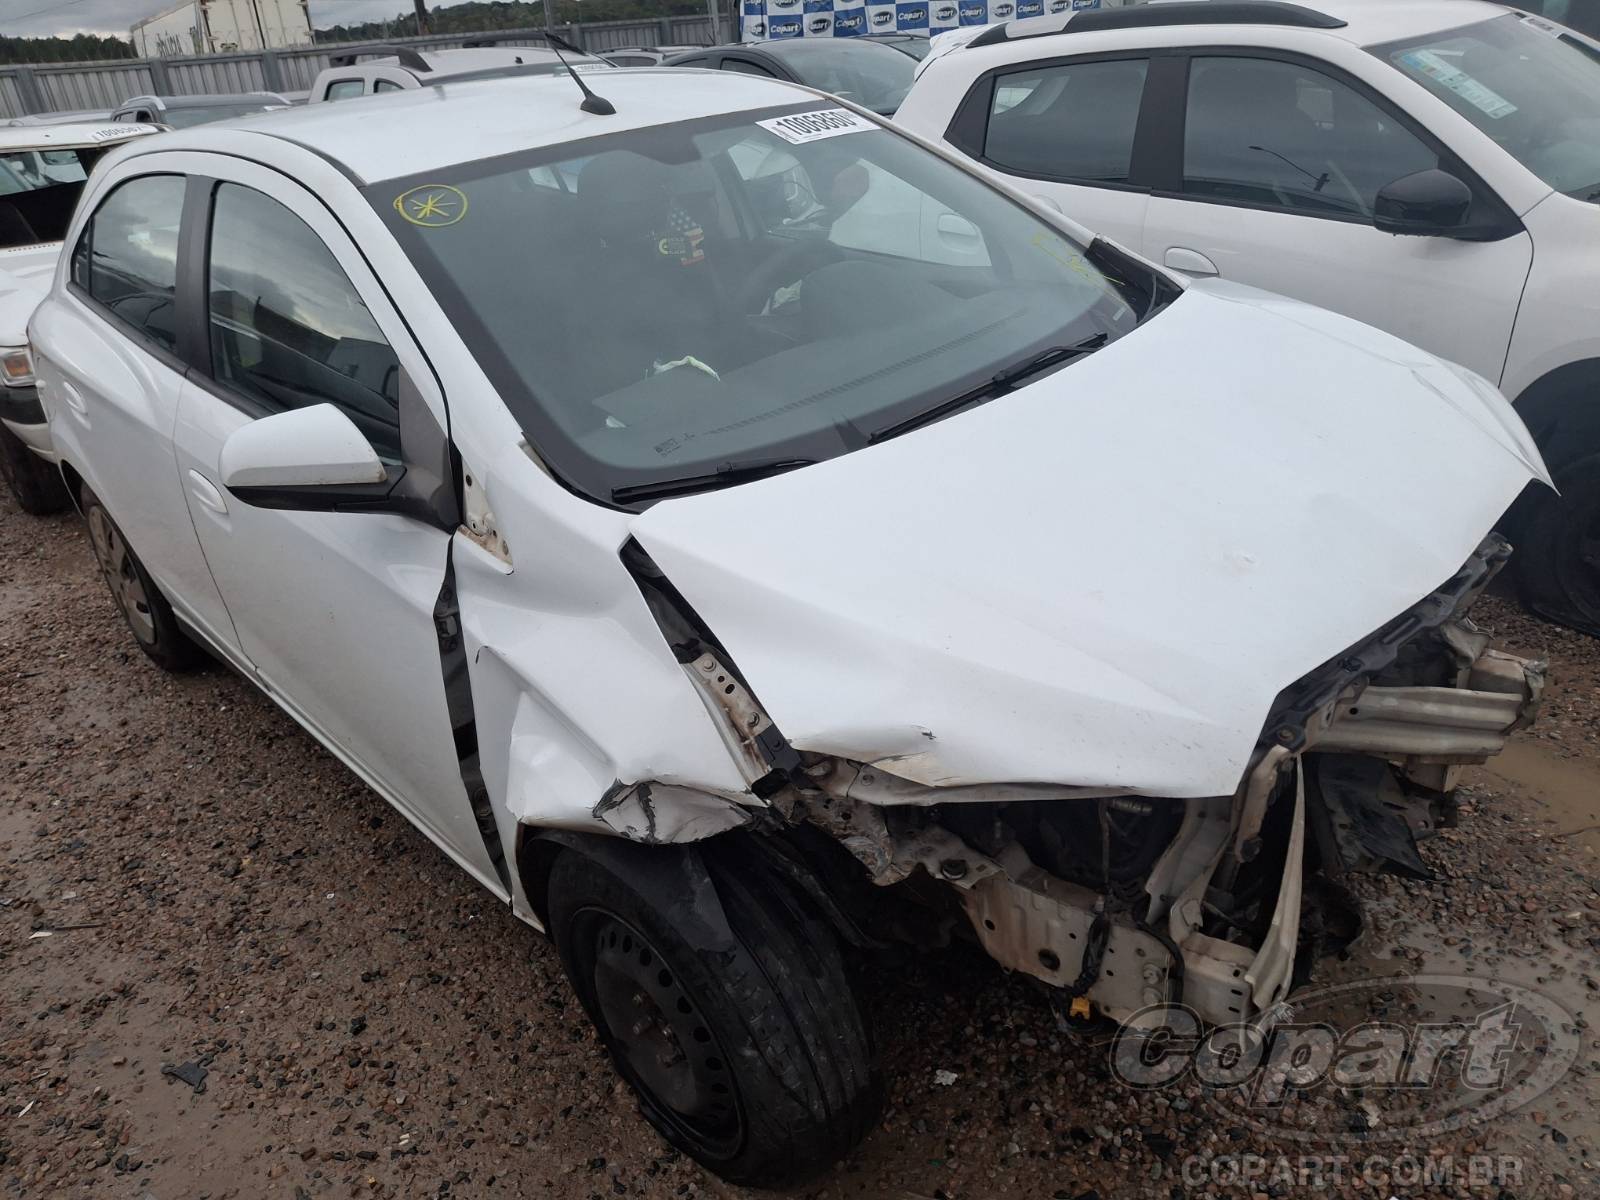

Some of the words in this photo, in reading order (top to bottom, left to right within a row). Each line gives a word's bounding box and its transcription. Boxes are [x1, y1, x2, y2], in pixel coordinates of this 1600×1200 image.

[898, 11, 923, 21] Copart
[770, 24, 798, 34] Copart
[775, 111, 857, 136] 1006860
